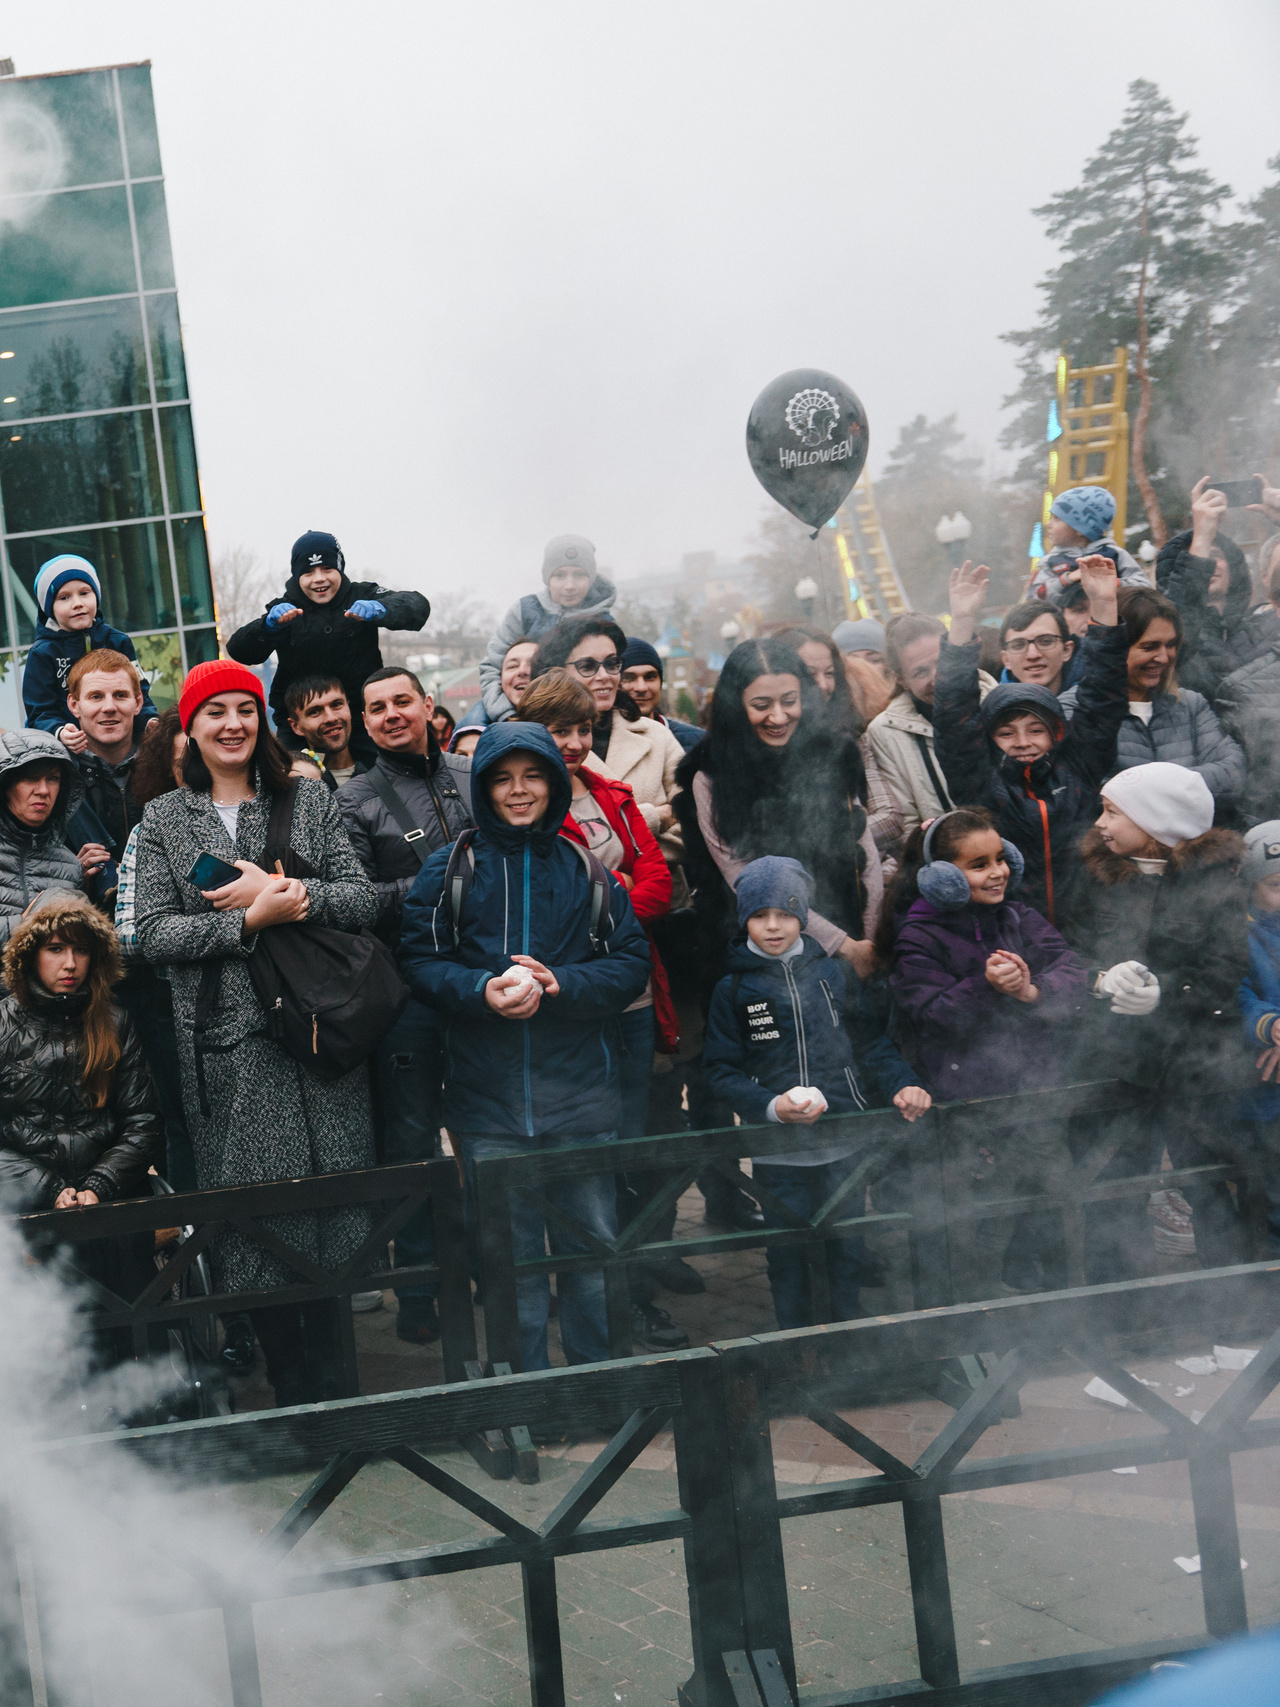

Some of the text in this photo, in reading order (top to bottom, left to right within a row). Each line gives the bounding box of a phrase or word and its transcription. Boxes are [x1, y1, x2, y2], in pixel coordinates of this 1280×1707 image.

[779, 435, 852, 469] HALLOWEEN
[747, 1003, 767, 1013] BOY
[749, 1016, 774, 1026] HOUR
[751, 1030, 780, 1041] CHAOS
